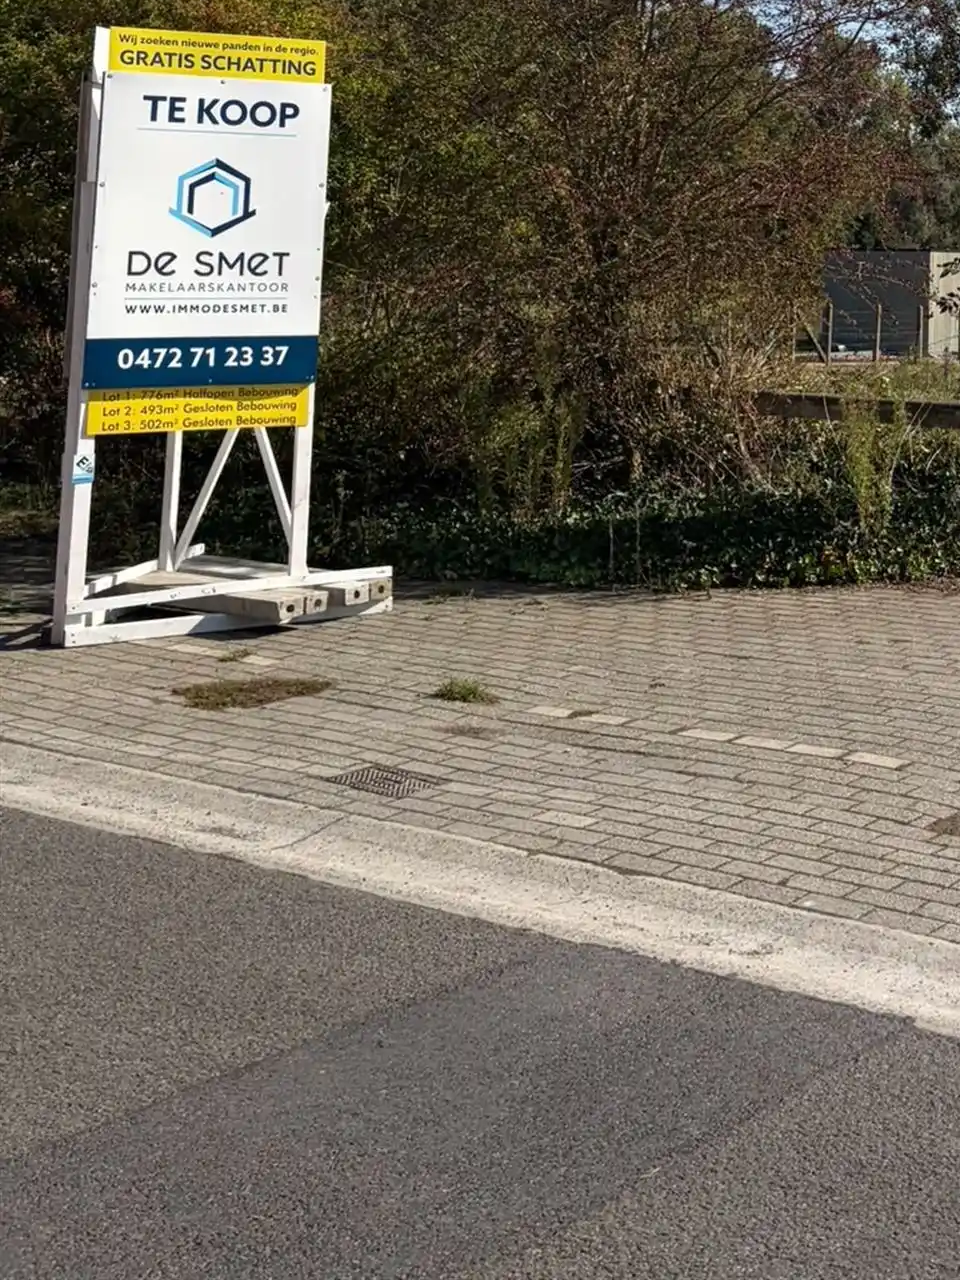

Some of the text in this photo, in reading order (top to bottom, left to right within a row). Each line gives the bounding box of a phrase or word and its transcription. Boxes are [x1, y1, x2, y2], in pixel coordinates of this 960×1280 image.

[119, 34, 319, 57] Wij zoeken nieuwe panden in de regio.
[119, 49, 317, 77] GRATIS SCHATTING
[143, 94, 300, 128] TE KOOP
[124, 282, 289, 293] MAKELAARSKANTOOR
[124, 303, 289, 314] WWW.IMMODESMET.BE
[117, 345, 289, 370] 0472 71 23 37
[102, 391, 121, 402] Lot
[183, 387, 234, 400] Halfopen
[238, 387, 299, 398] Bebouwing
[102, 406, 121, 417] Lot
[124, 406, 136, 416] 2:
[183, 401, 233, 413] Gesloten
[236, 400, 297, 413] Bebouwing
[101, 421, 120, 432] Lot
[123, 420, 135, 431] 3:
[182, 417, 232, 428] Gesloten
[236, 415, 296, 426] Bebouwing
